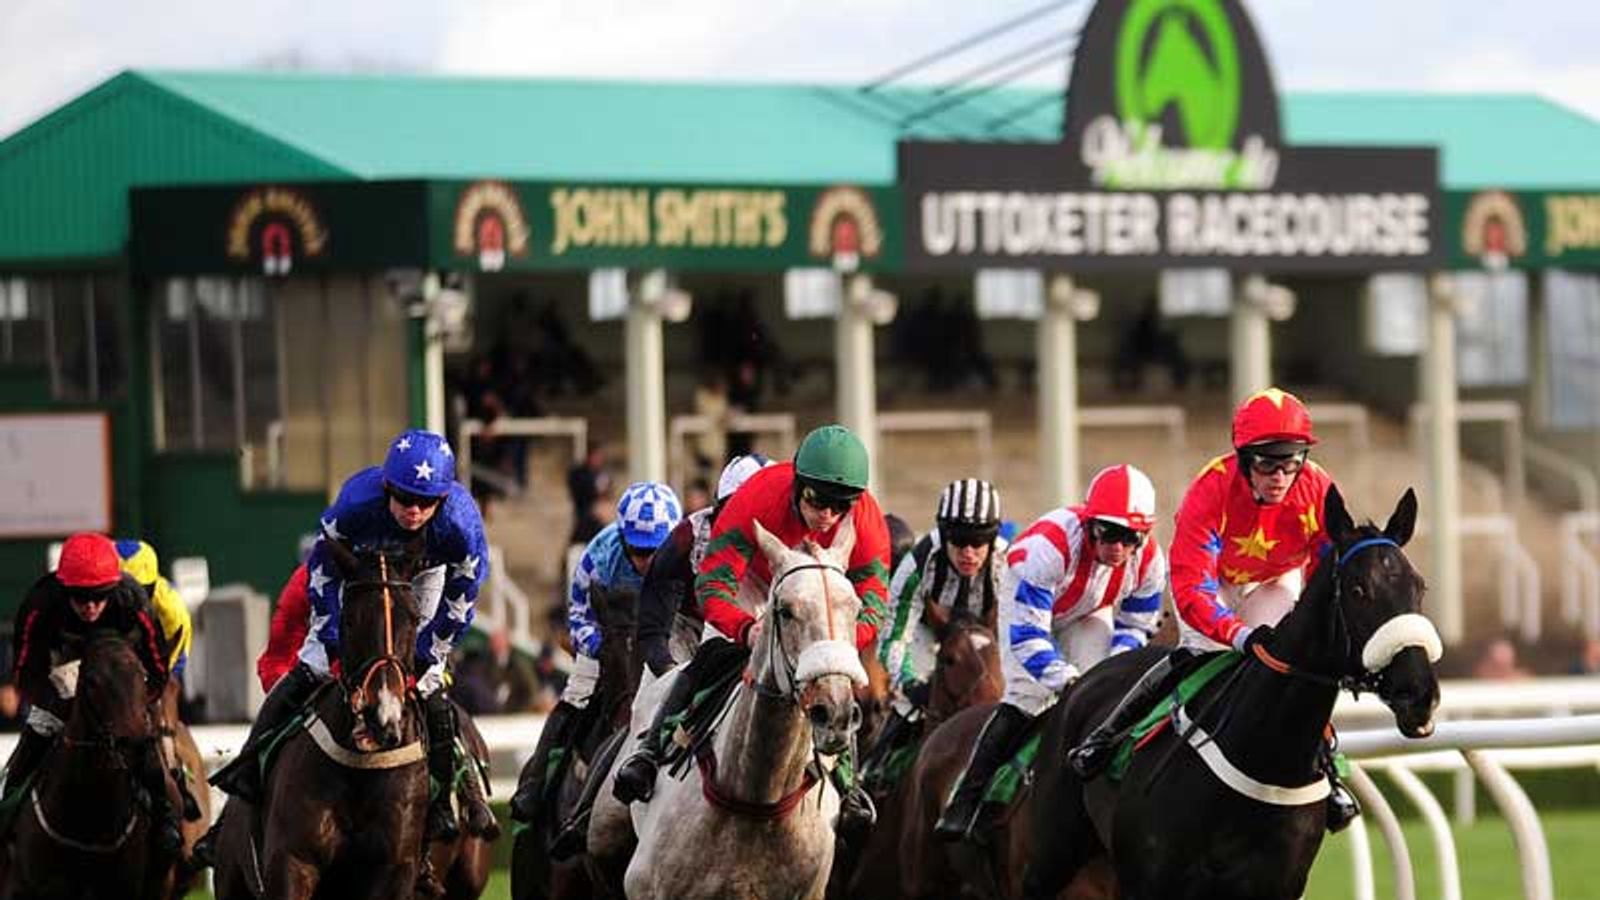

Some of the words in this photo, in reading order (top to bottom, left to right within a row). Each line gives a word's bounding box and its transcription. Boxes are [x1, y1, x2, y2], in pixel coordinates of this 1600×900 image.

[551, 188, 649, 254] JOHN
[654, 189, 787, 246] SMITH'S
[1167, 193, 1428, 255] RACECOURSE
